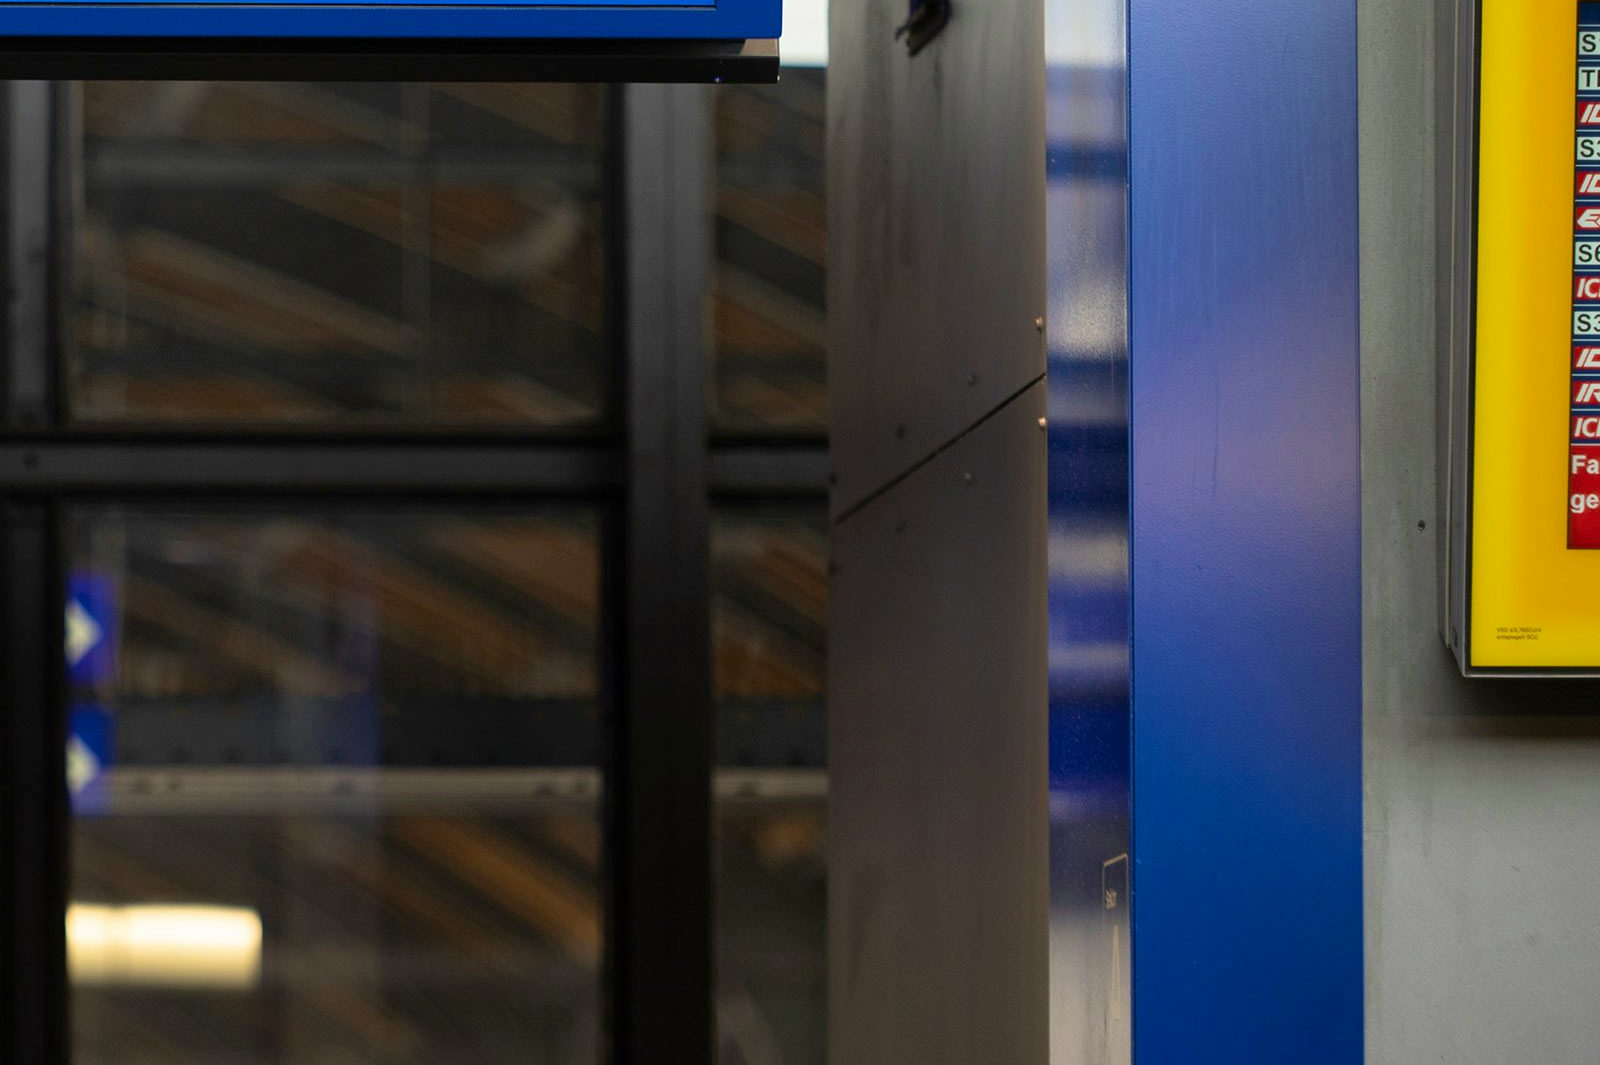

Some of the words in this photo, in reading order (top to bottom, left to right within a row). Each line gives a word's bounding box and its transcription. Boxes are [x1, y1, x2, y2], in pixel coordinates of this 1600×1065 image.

[1582, 34, 1600, 52] S
[1580, 139, 1600, 158] S
[1576, 278, 1600, 298] IC
[1575, 417, 1600, 437] IC
